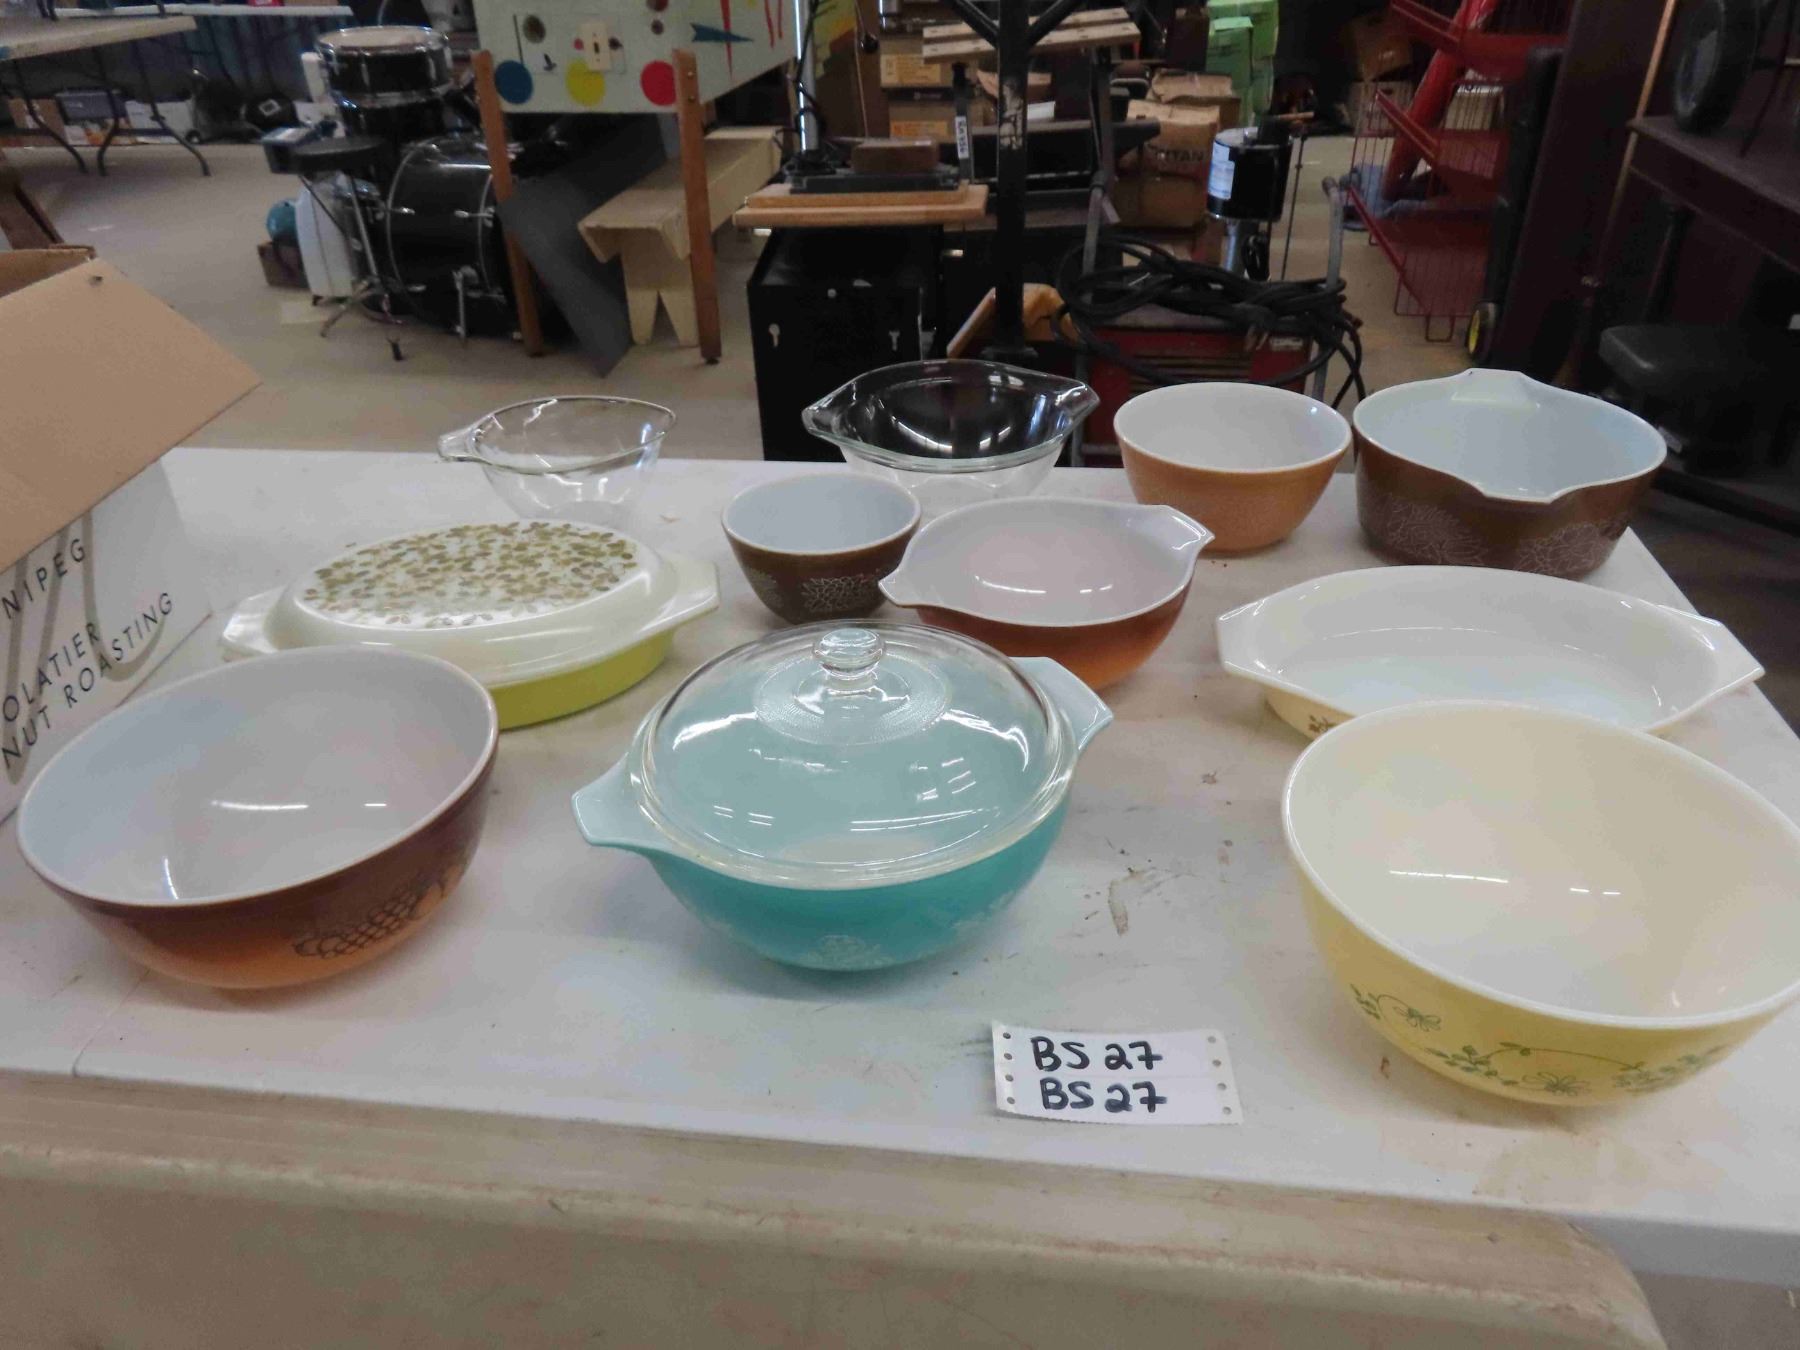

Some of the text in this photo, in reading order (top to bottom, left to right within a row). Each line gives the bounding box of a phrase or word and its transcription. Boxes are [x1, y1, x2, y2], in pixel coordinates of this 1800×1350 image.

[1, 592, 174, 769] NUT ROASTING
[1030, 1035, 1164, 1072] BS 27
[1039, 1076, 1168, 1113] BS 27
